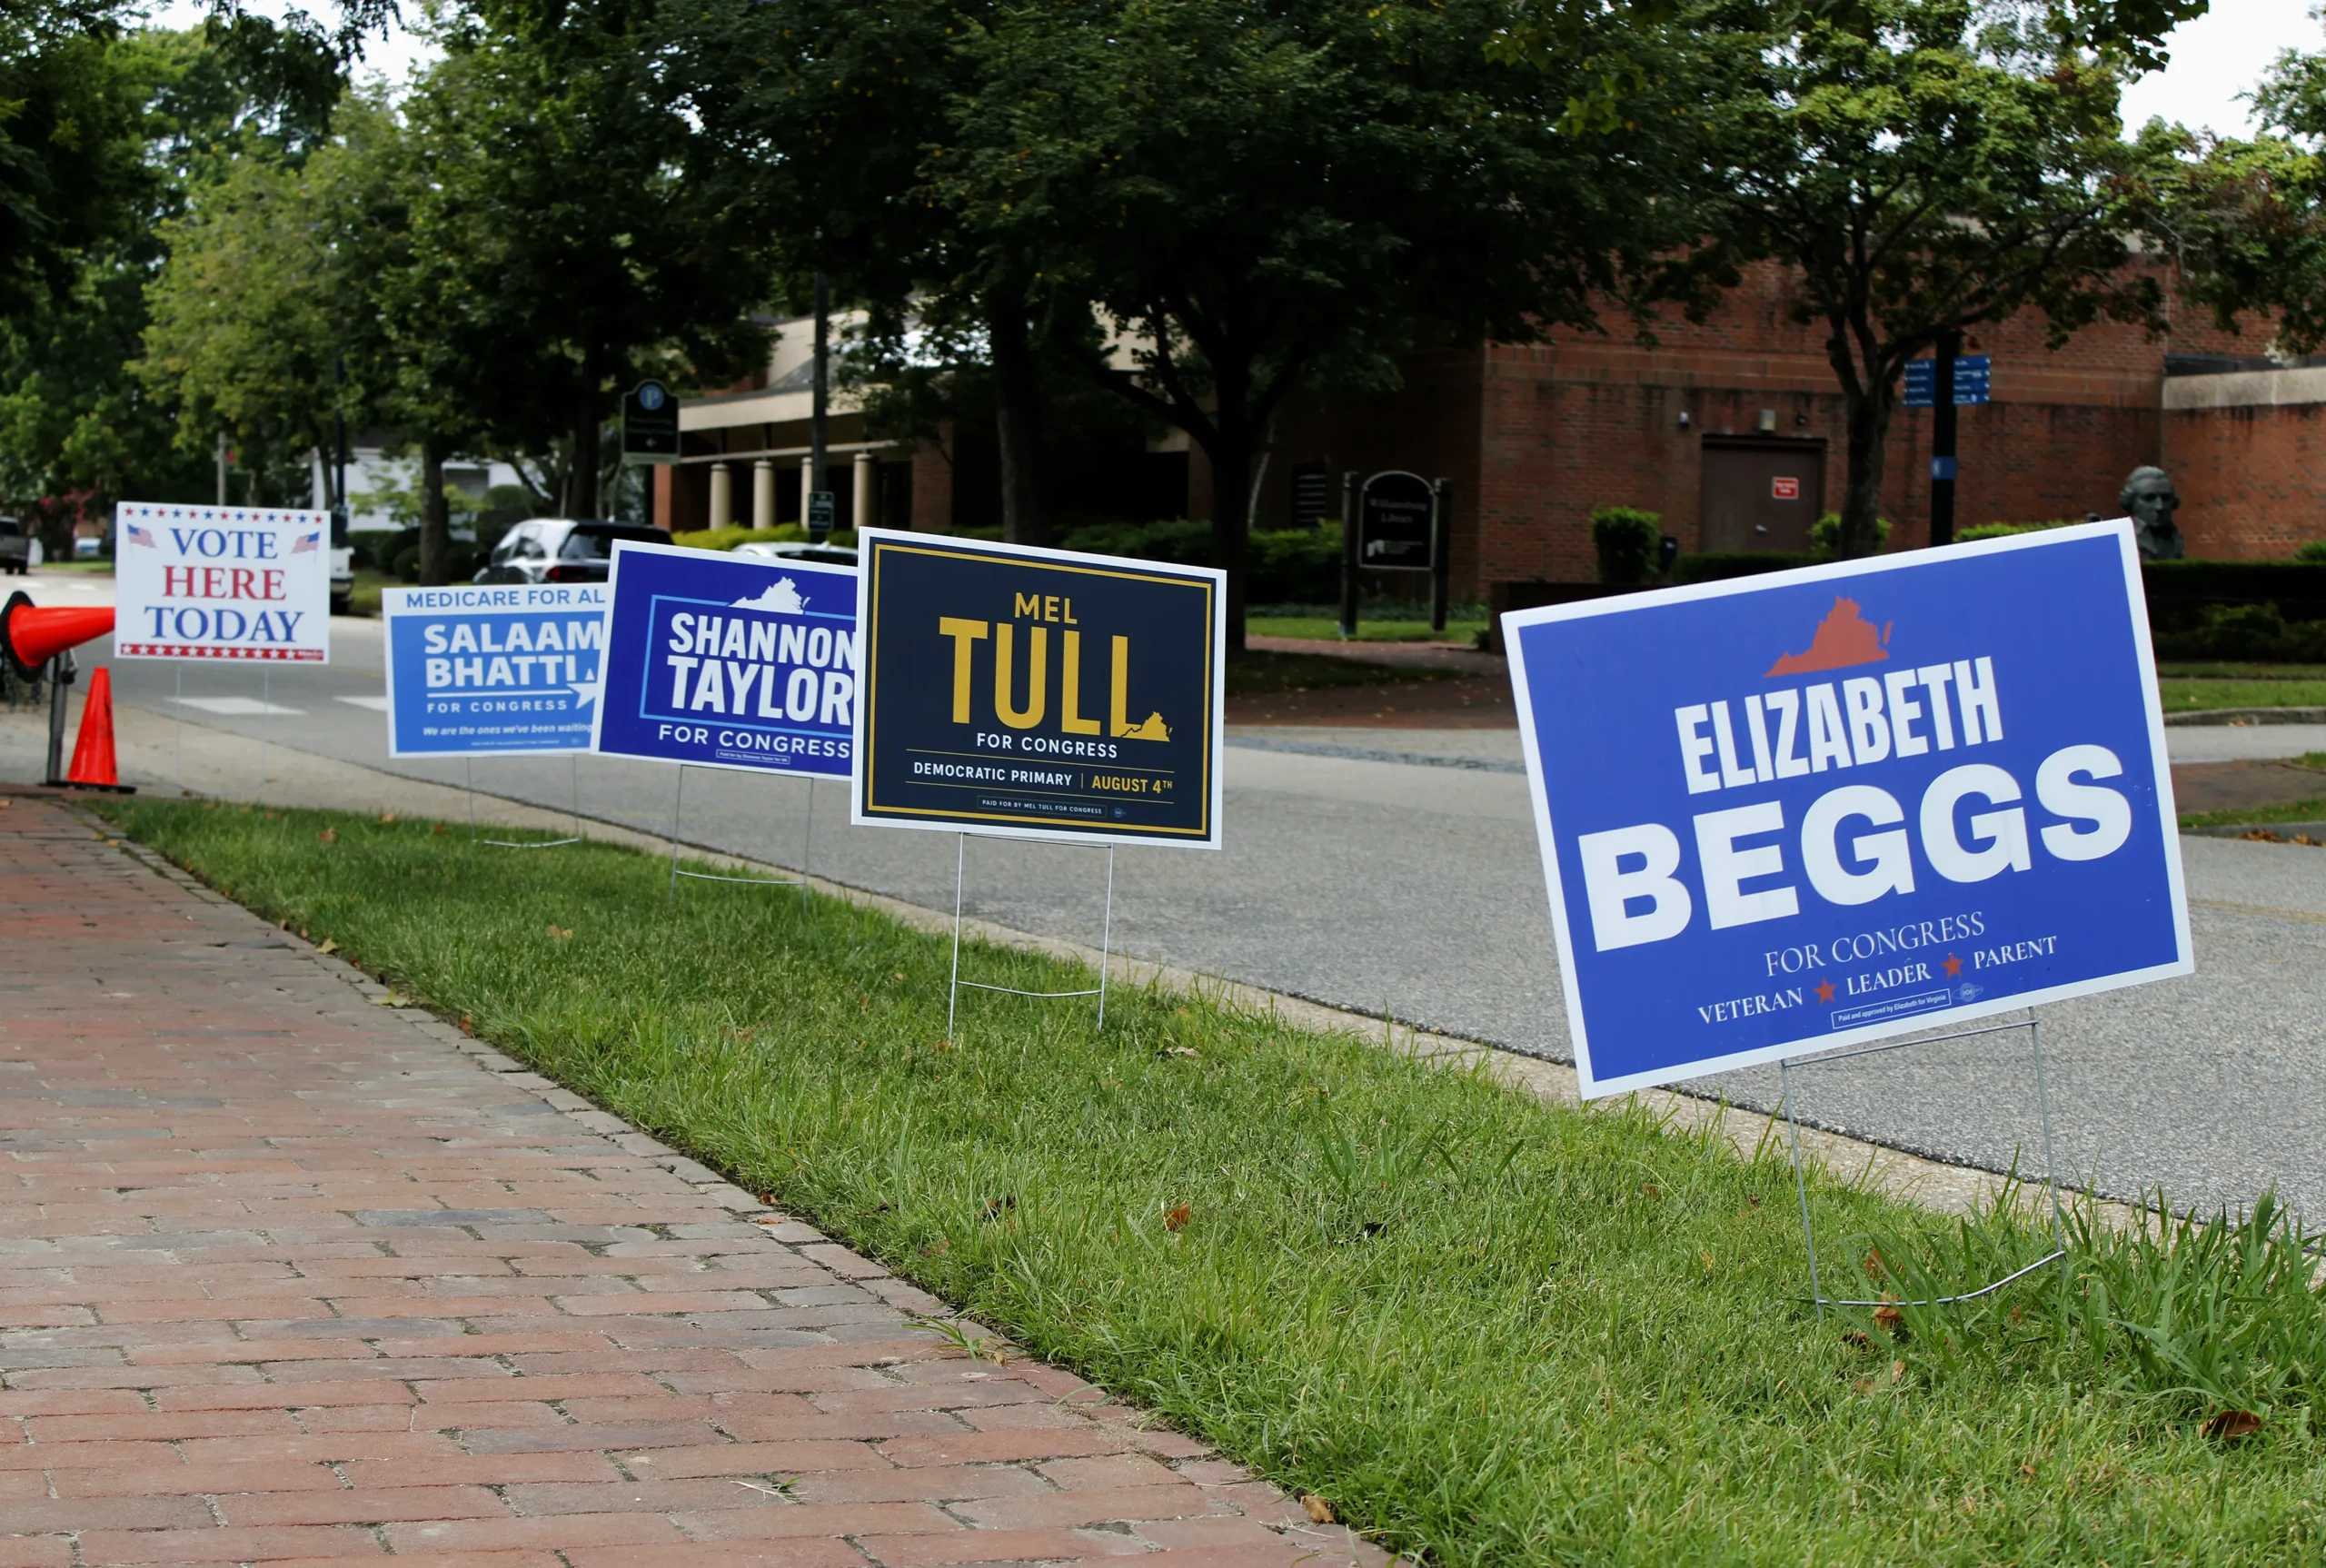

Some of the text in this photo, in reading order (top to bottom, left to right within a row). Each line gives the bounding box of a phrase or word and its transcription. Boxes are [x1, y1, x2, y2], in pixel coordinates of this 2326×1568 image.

[169, 528, 278, 559] VOTE
[163, 565, 287, 600] HERE
[406, 589, 606, 608] MEDICARE FOR AL
[144, 606, 305, 642] TODAY
[1014, 592, 1078, 625] MEL
[423, 620, 602, 654] SALAAM
[669, 612, 856, 670] SHANNON
[425, 655, 577, 688] BHATTI
[939, 616, 1170, 742] TULL
[427, 700, 567, 714] FOR CONGRESS
[667, 655, 854, 726] TAYLOR
[423, 727, 438, 736] We
[440, 728, 457, 736] are
[459, 726, 474, 735] the
[477, 727, 501, 735] ones
[531, 724, 556, 733] been
[659, 724, 850, 759] FOR CONGRESS
[1675, 656, 2003, 795] ELIZABETH
[977, 733, 1118, 759] FOR CONGRESS
[914, 761, 1173, 794] DEMOCRATIC PRIMARY AUGUST 4TH
[1577, 744, 2132, 952] BEGGS
[1764, 911, 1985, 978] FOR CONGRESS
[1698, 935, 2058, 1025] VETERAN LEADER PARENT
[1838, 1014, 1851, 1022] Paid
[1851, 1011, 1861, 1019] and
[1862, 1006, 1886, 1017] approved
[1886, 1005, 1894, 1013] by
[1894, 999, 1918, 1010] Elizabeth
[1926, 995, 1946, 1004] Virginia
